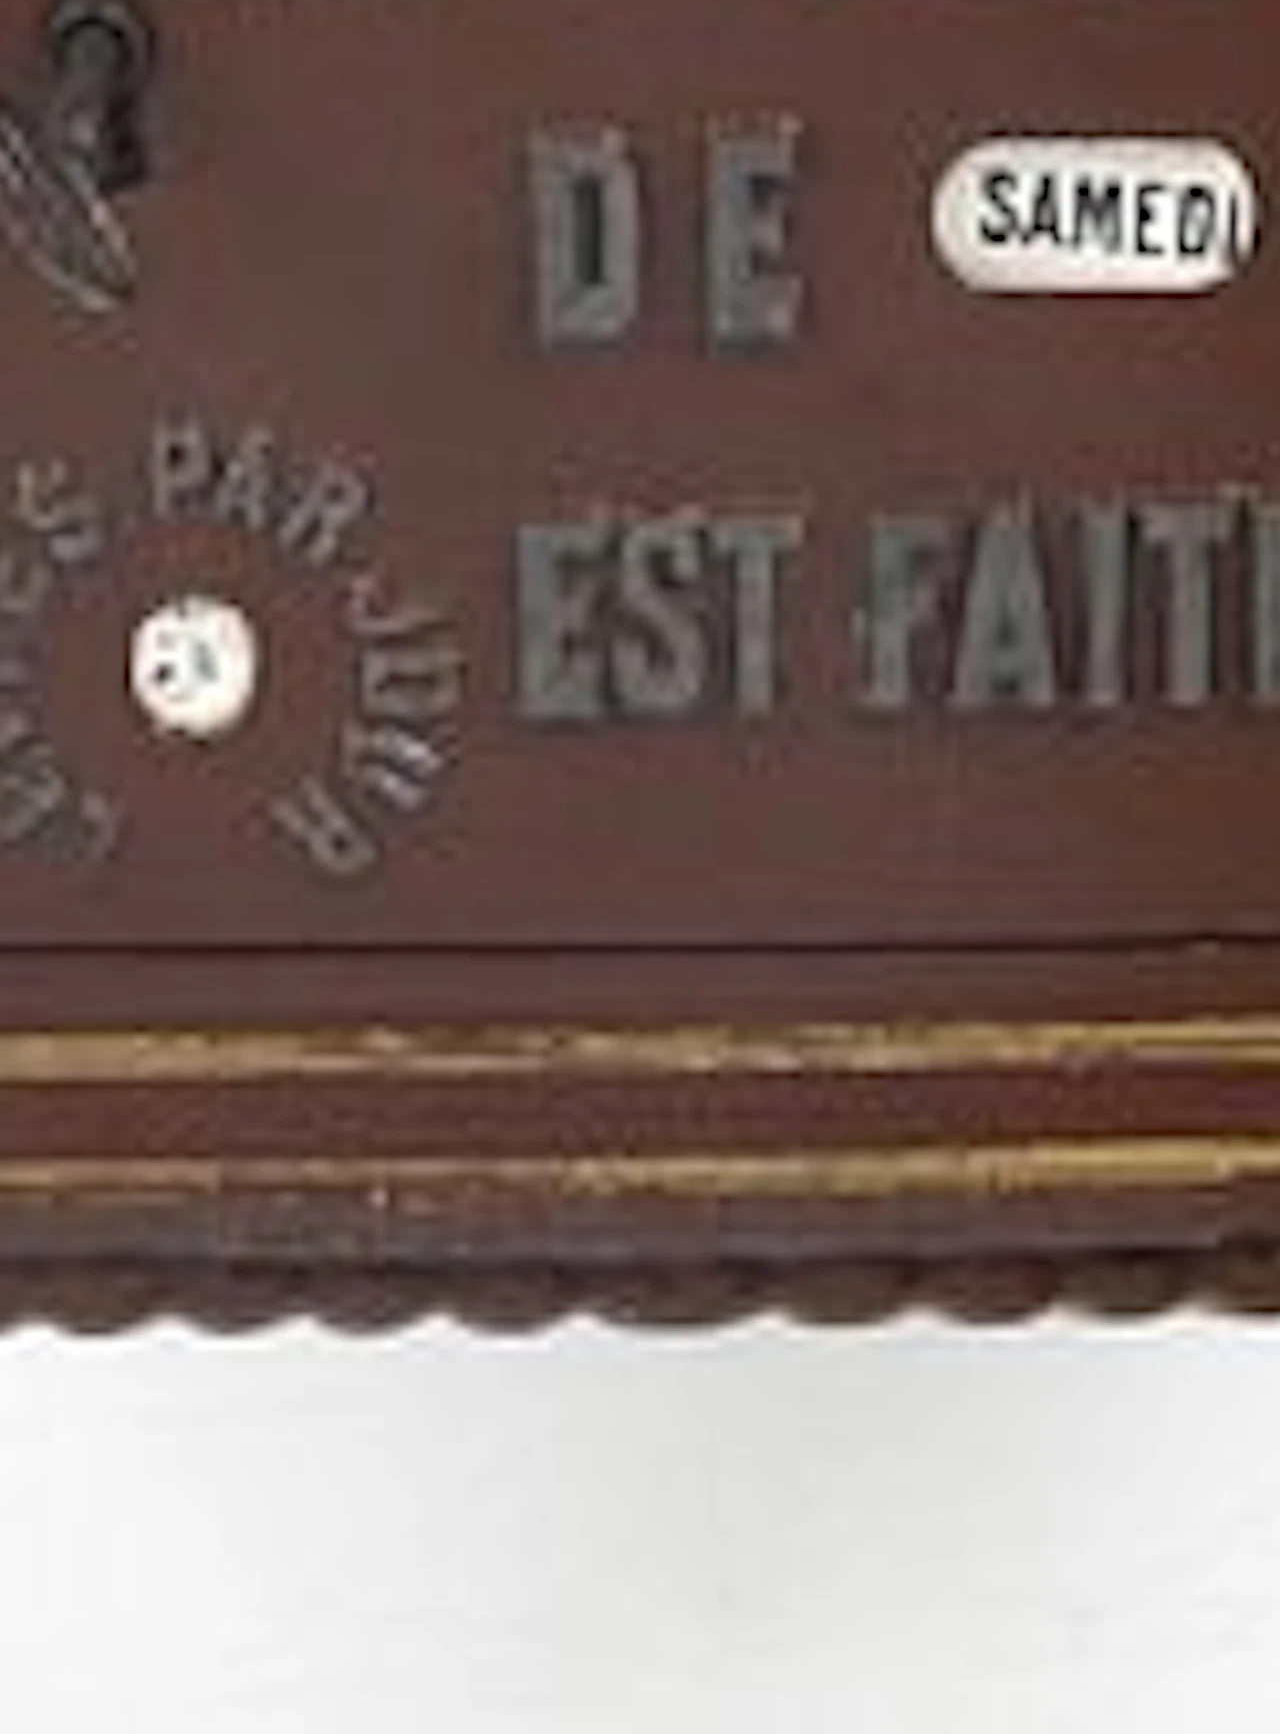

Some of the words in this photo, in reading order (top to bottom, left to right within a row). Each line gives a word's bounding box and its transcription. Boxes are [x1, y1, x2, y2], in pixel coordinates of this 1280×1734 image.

[528, 126, 802, 343] DE
[980, 167, 1242, 261] SAMEDI
[152, 419, 372, 566] PAR
[270, 571, 465, 873] JOUR
[518, 516, 804, 719] EST
